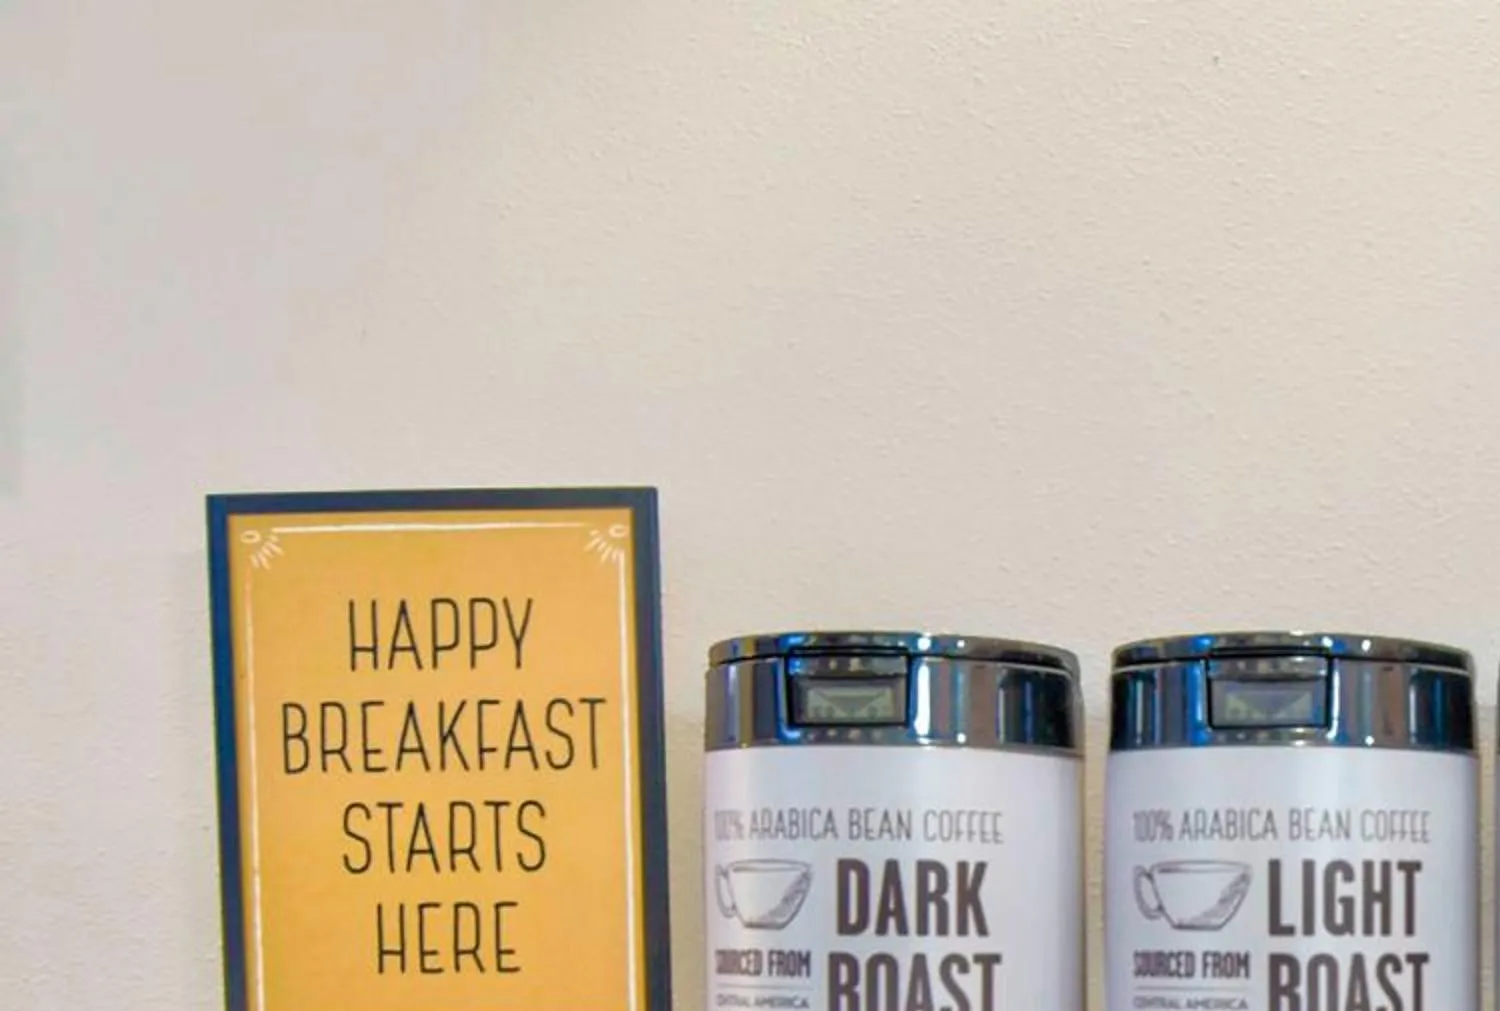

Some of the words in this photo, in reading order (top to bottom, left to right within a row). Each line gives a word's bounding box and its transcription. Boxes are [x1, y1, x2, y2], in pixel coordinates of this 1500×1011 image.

[349, 597, 533, 671] HAPPY
[282, 698, 606, 774] BREAKFAST
[342, 800, 547, 874] STARTS
[749, 807, 839, 841] ARABICA
[848, 808, 912, 841] BEAN
[923, 810, 1004, 844] COFFEE
[1133, 808, 1174, 842] 100%
[1179, 808, 1279, 841] ARABICA
[1288, 808, 1352, 842] BEAN
[1361, 810, 1431, 843] COFFEE
[836, 858, 990, 937] DARK
[1268, 859, 1422, 937] LIGHT
[376, 902, 521, 974] HERE
[768, 950, 811, 978] FROM
[1133, 950, 1195, 978] SOURCED
[1202, 951, 1250, 980] FROM
